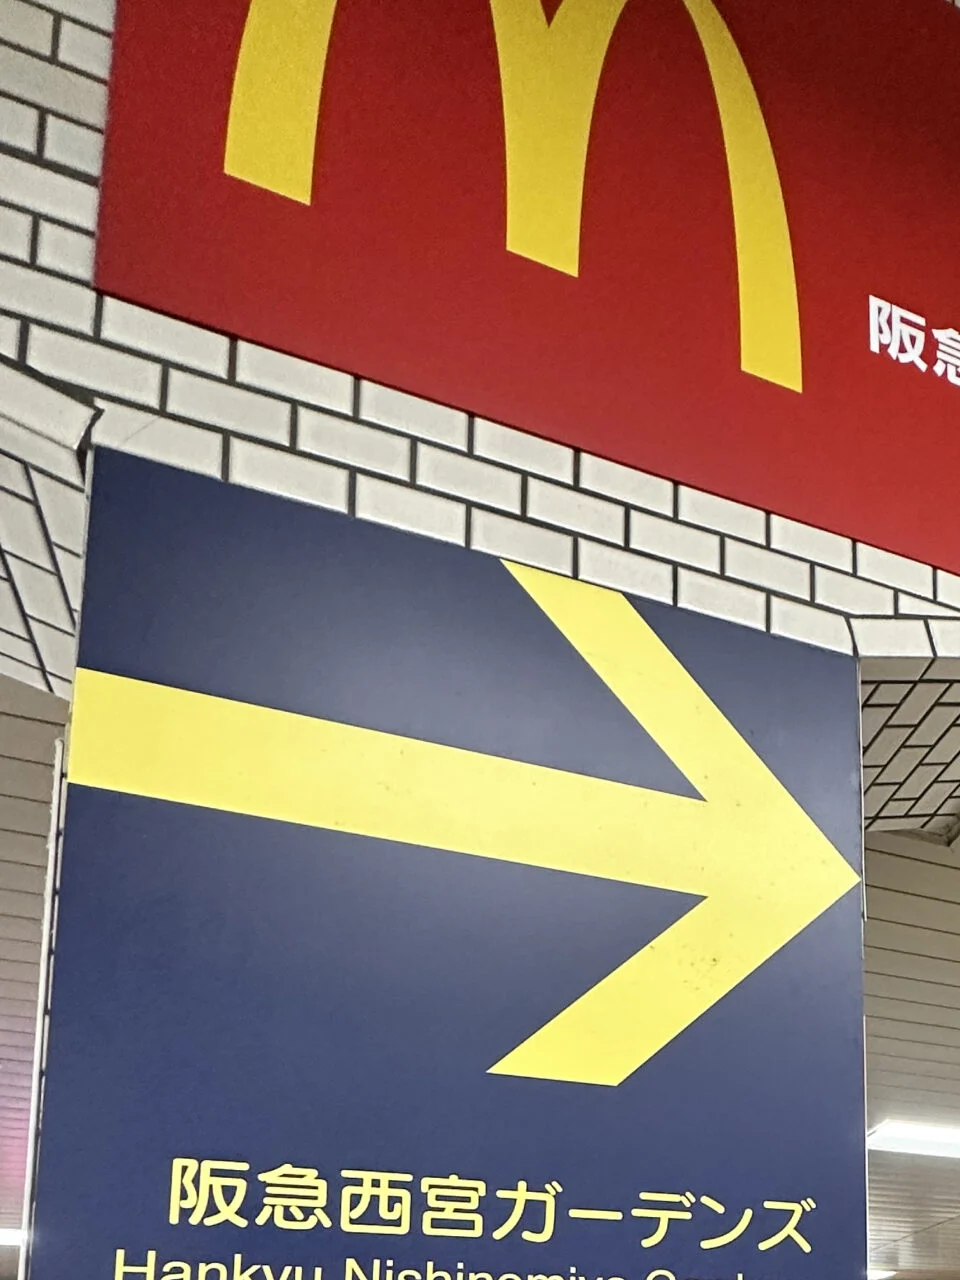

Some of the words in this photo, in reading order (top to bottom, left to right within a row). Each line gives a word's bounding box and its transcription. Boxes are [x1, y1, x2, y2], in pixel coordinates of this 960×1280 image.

[168, 1156, 817, 1253] 阪急西宮ガーデンズ
